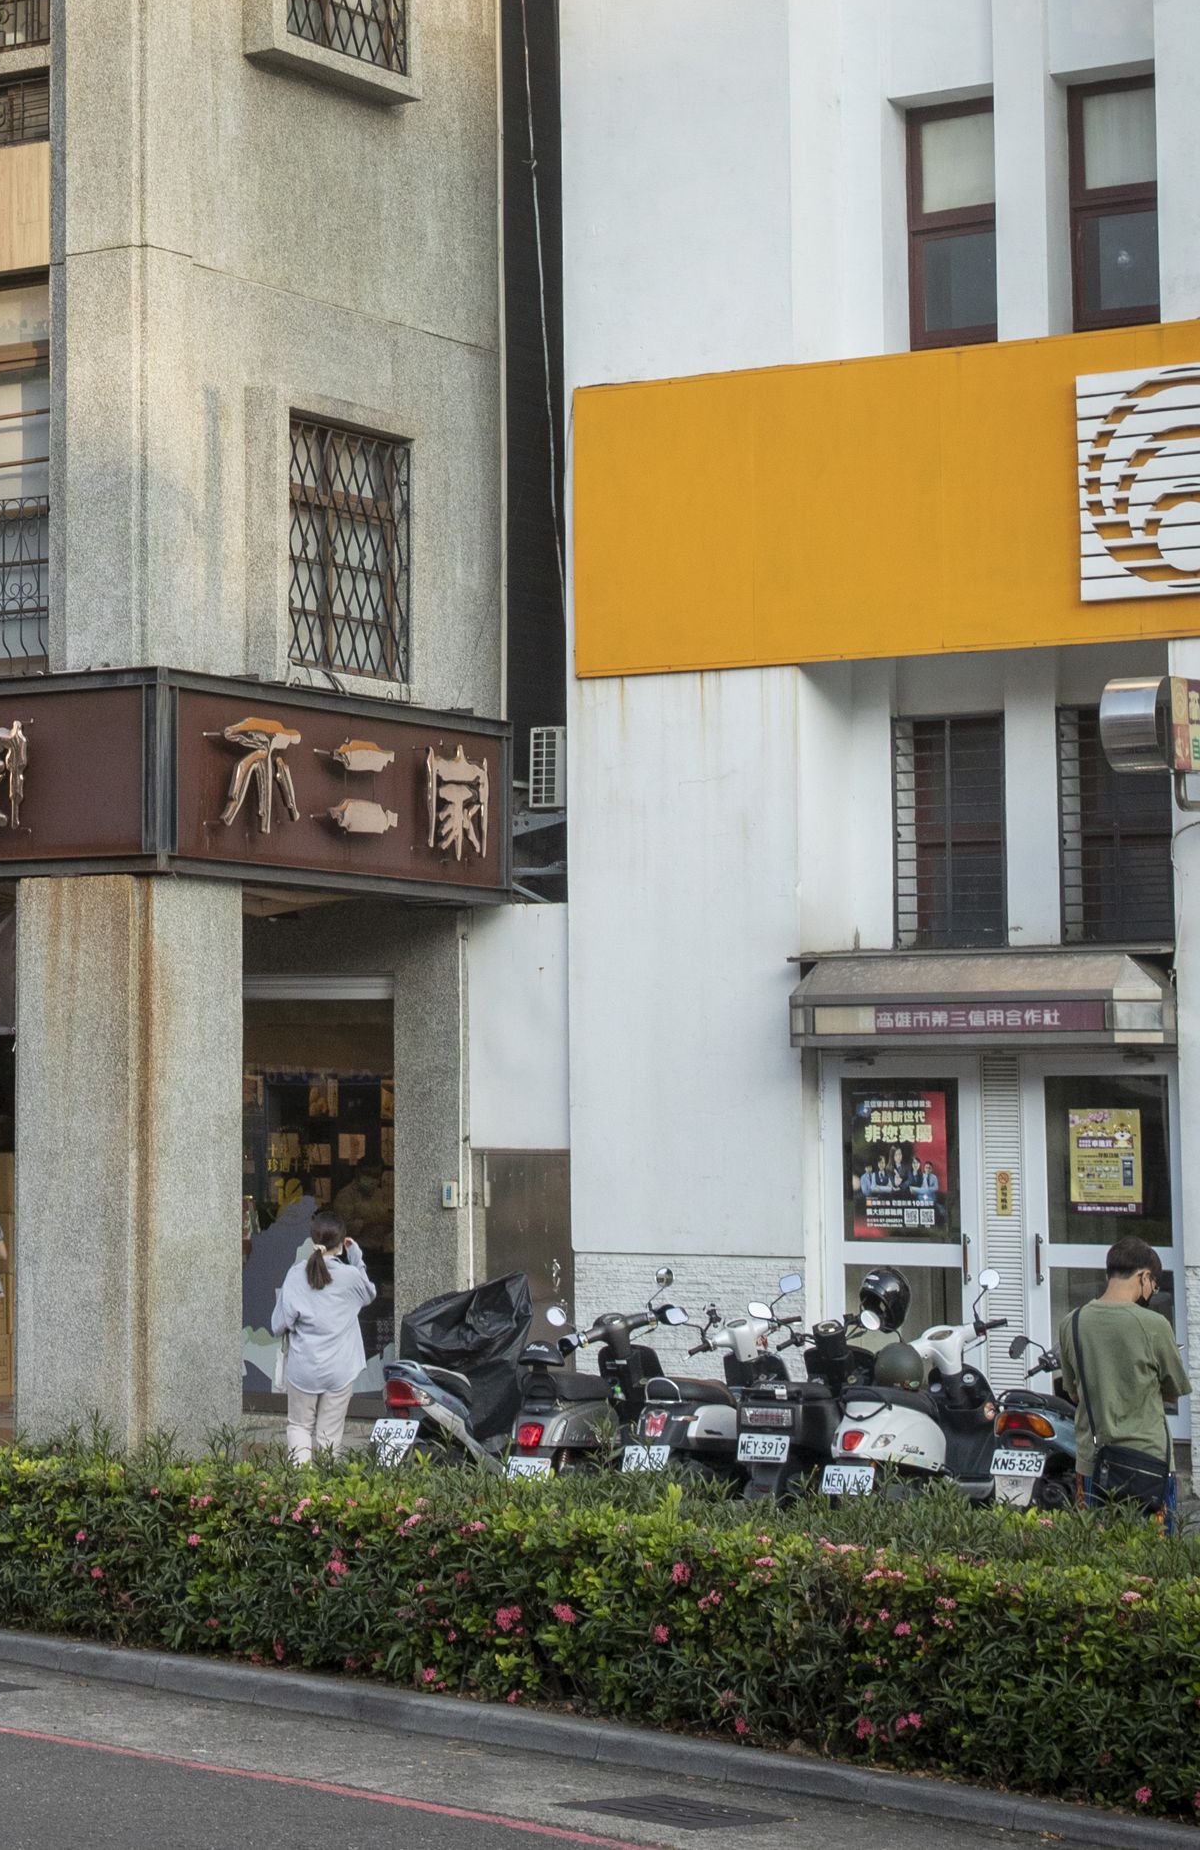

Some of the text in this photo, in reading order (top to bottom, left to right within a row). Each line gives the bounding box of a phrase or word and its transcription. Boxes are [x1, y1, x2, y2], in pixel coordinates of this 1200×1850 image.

[220, 716, 490, 862] 不二家
[876, 1008, 1062, 1029] 高雄市第三信用合作社
[739, 1440, 788, 1456] MEY-3919
[992, 1457, 1044, 1474] KN5-529
